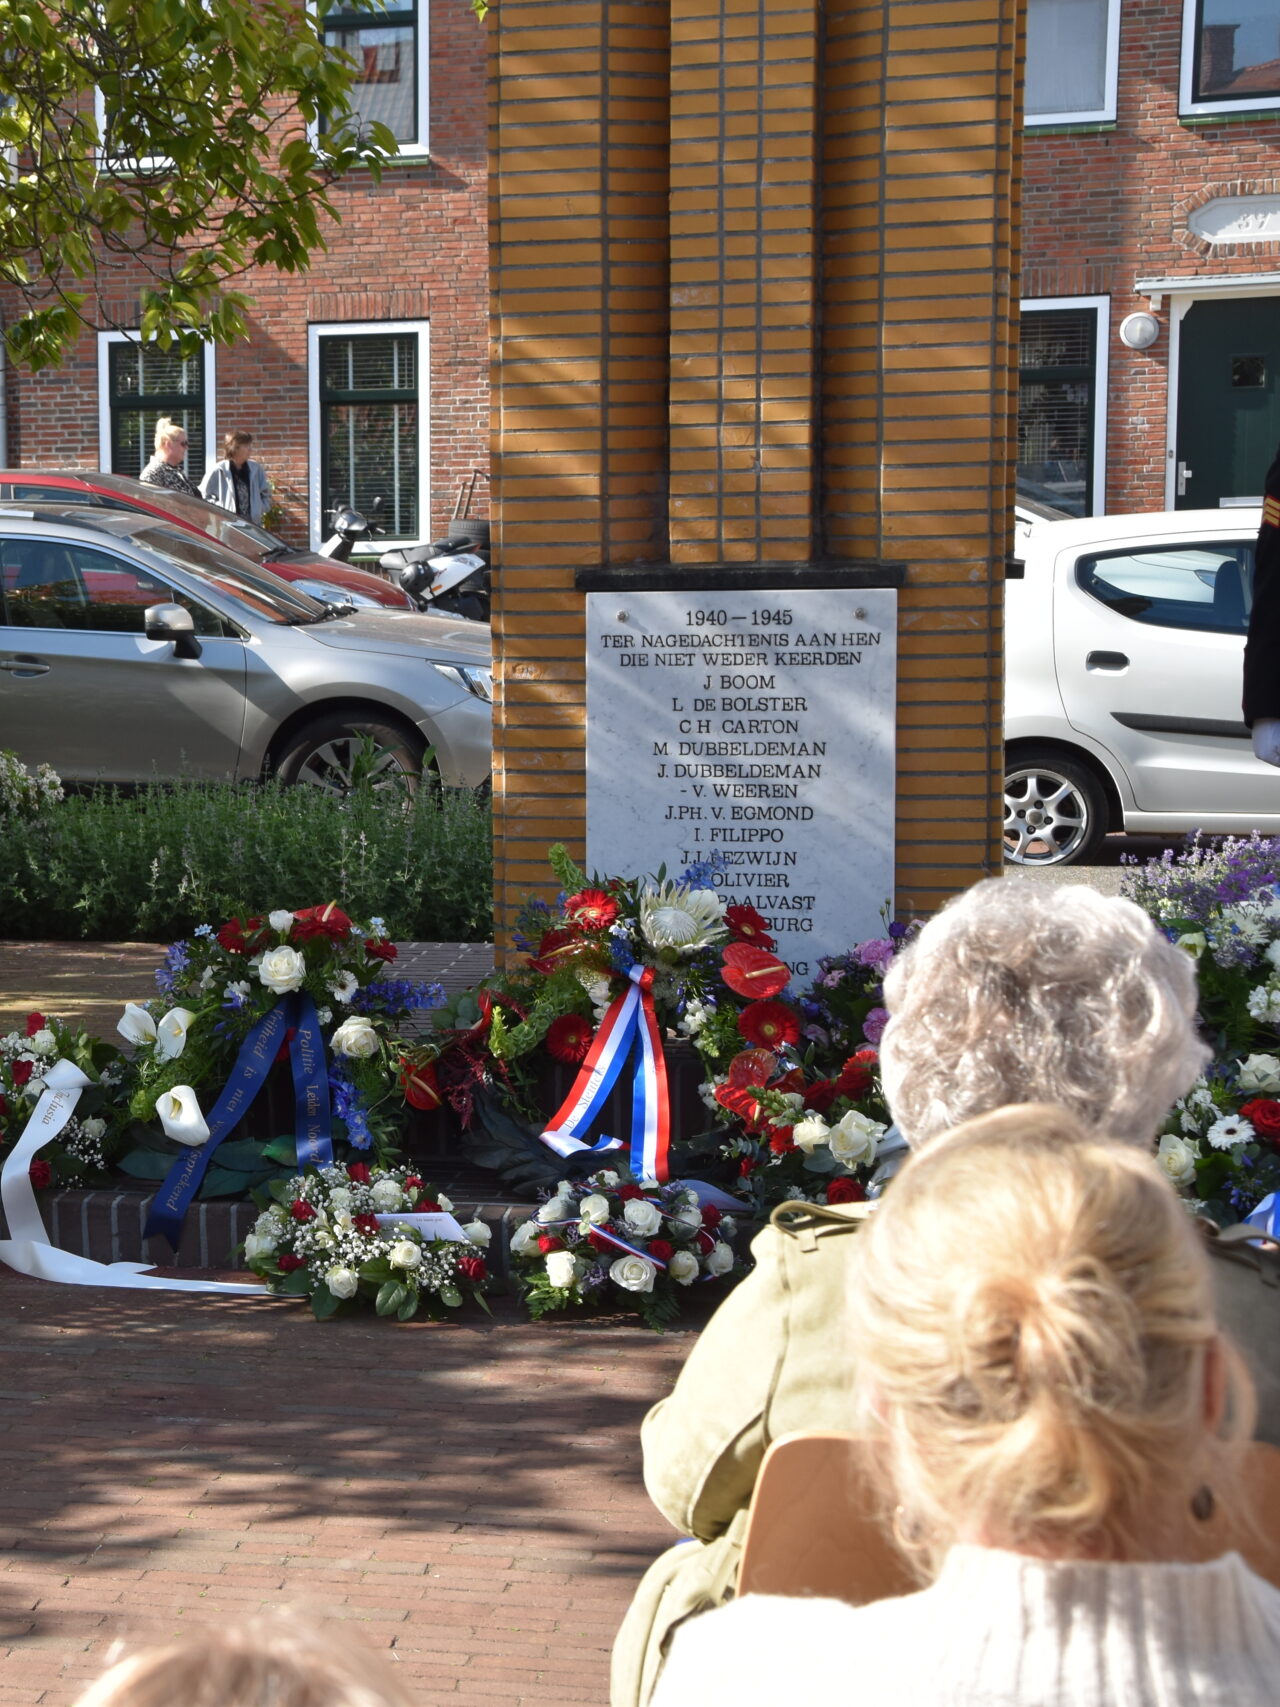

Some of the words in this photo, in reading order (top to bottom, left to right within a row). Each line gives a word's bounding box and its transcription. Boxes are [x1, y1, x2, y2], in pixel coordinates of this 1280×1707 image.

[686, 610, 728, 626] 1940
[751, 609, 793, 626] 1945
[601, 634, 635, 648] TER
[641, 633, 789, 648] NAGEDACHTENIS
[794, 633, 837, 647] AAN
[840, 632, 882, 646] HEN
[620, 653, 649, 667] DIE
[654, 653, 696, 667] NIET
[702, 652, 768, 667] WEDER
[773, 651, 862, 666] KEERDEN
[720, 675, 776, 689] BOOM
[693, 698, 716, 712] DE
[722, 697, 808, 712] BOLSTER
[722, 719, 799, 734] CARTON
[679, 741, 827, 756] DUBBELDEMAN
[657, 764, 669, 778] J.
[674, 764, 822, 778] DUBBELDEMAN
[693, 785, 707, 798] V.
[713, 784, 799, 798] WEEREN
[731, 806, 814, 821] EGMOND
[710, 828, 784, 842] FILIPPO
[711, 873, 789, 888] OLIVIER
[718, 896, 816, 910] PAALVAST
[299, 1029, 313, 1074] Politie
[244, 1066, 258, 1079] is
[227, 1088, 245, 1112] niet
[306, 1085, 319, 1117] Leiden
[308, 1124, 323, 1163] Noord
